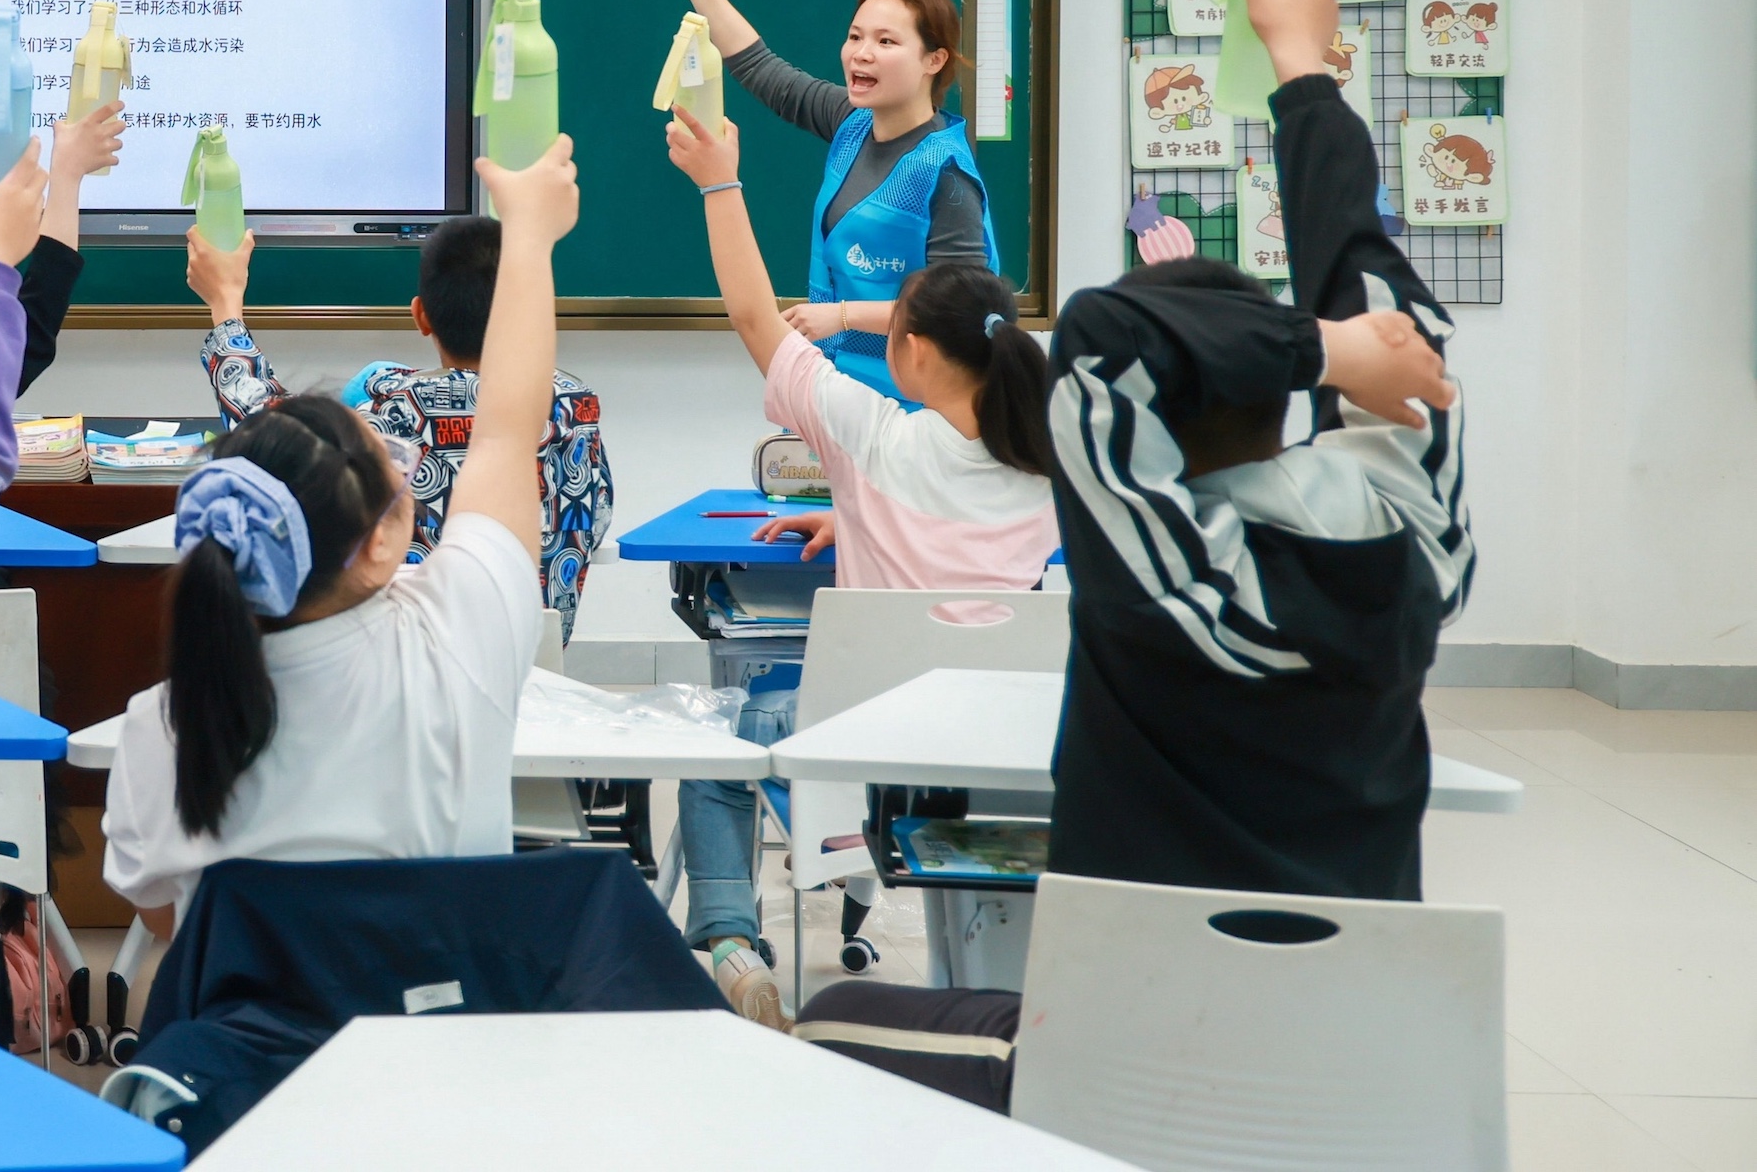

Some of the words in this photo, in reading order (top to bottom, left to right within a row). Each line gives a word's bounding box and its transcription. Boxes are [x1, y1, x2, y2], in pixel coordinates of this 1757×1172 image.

[1430, 53, 1486, 68] 轻声交流
[1146, 140, 1222, 159] 遵守纪律
[1414, 196, 1489, 215] 举手发言
